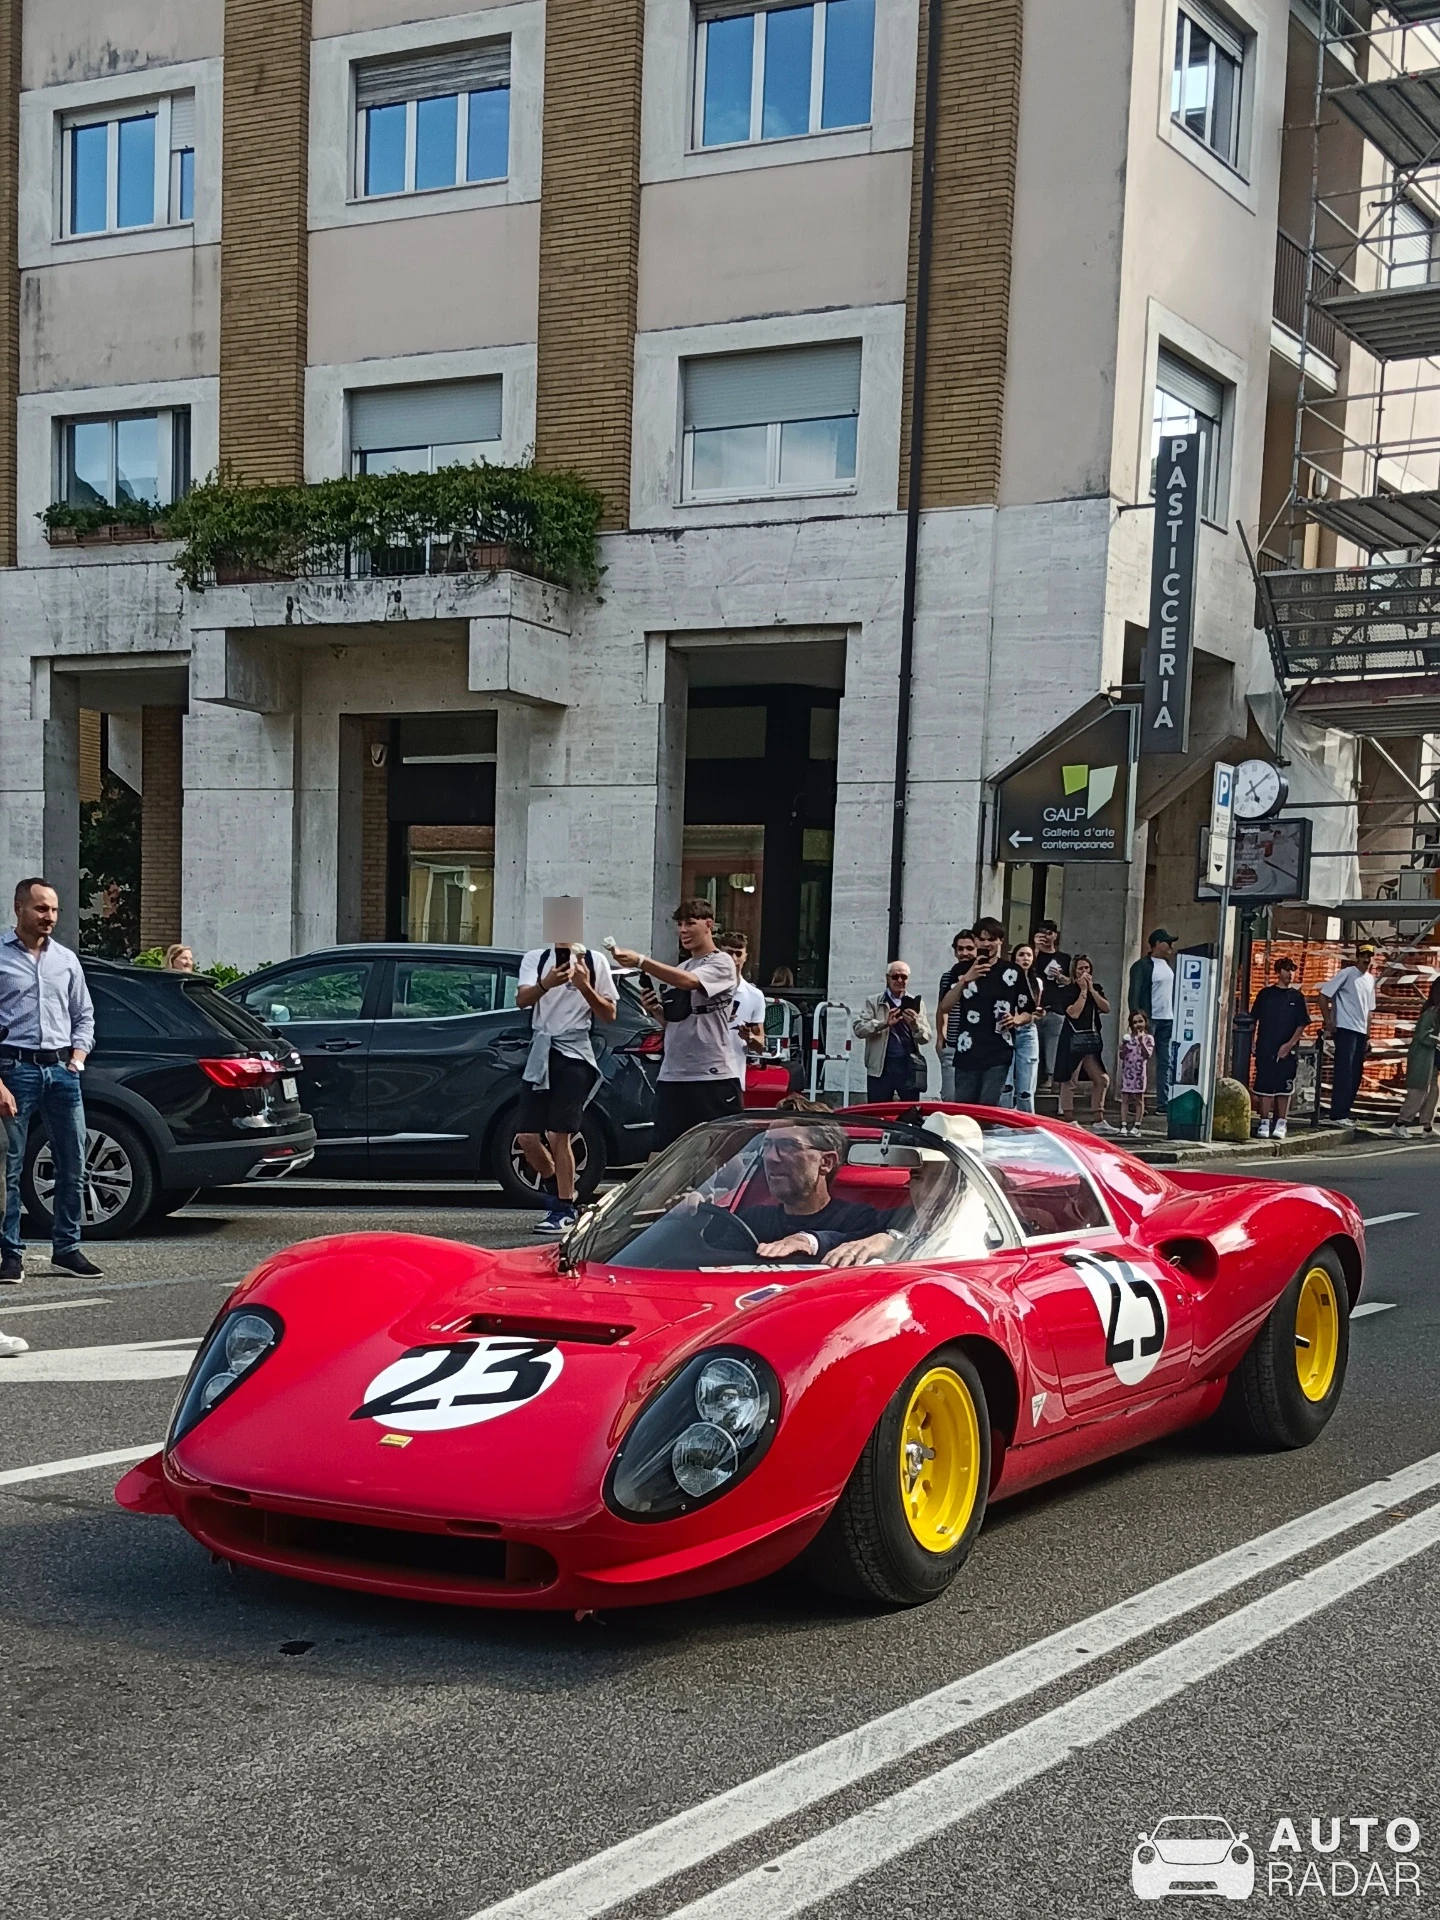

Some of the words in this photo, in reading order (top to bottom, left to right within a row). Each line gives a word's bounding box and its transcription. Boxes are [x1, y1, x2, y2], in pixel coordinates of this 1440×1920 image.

[1153, 439, 1188, 729] PASTICCERIA
[1218, 773, 1229, 803] P
[1043, 807, 1086, 822] GALP
[1042, 827, 1080, 837] Galleria
[1084, 827, 1115, 837] d'arte
[1041, 840, 1114, 851] contemporanea
[1185, 961, 1200, 979] P
[348, 1341, 558, 1420] 23
